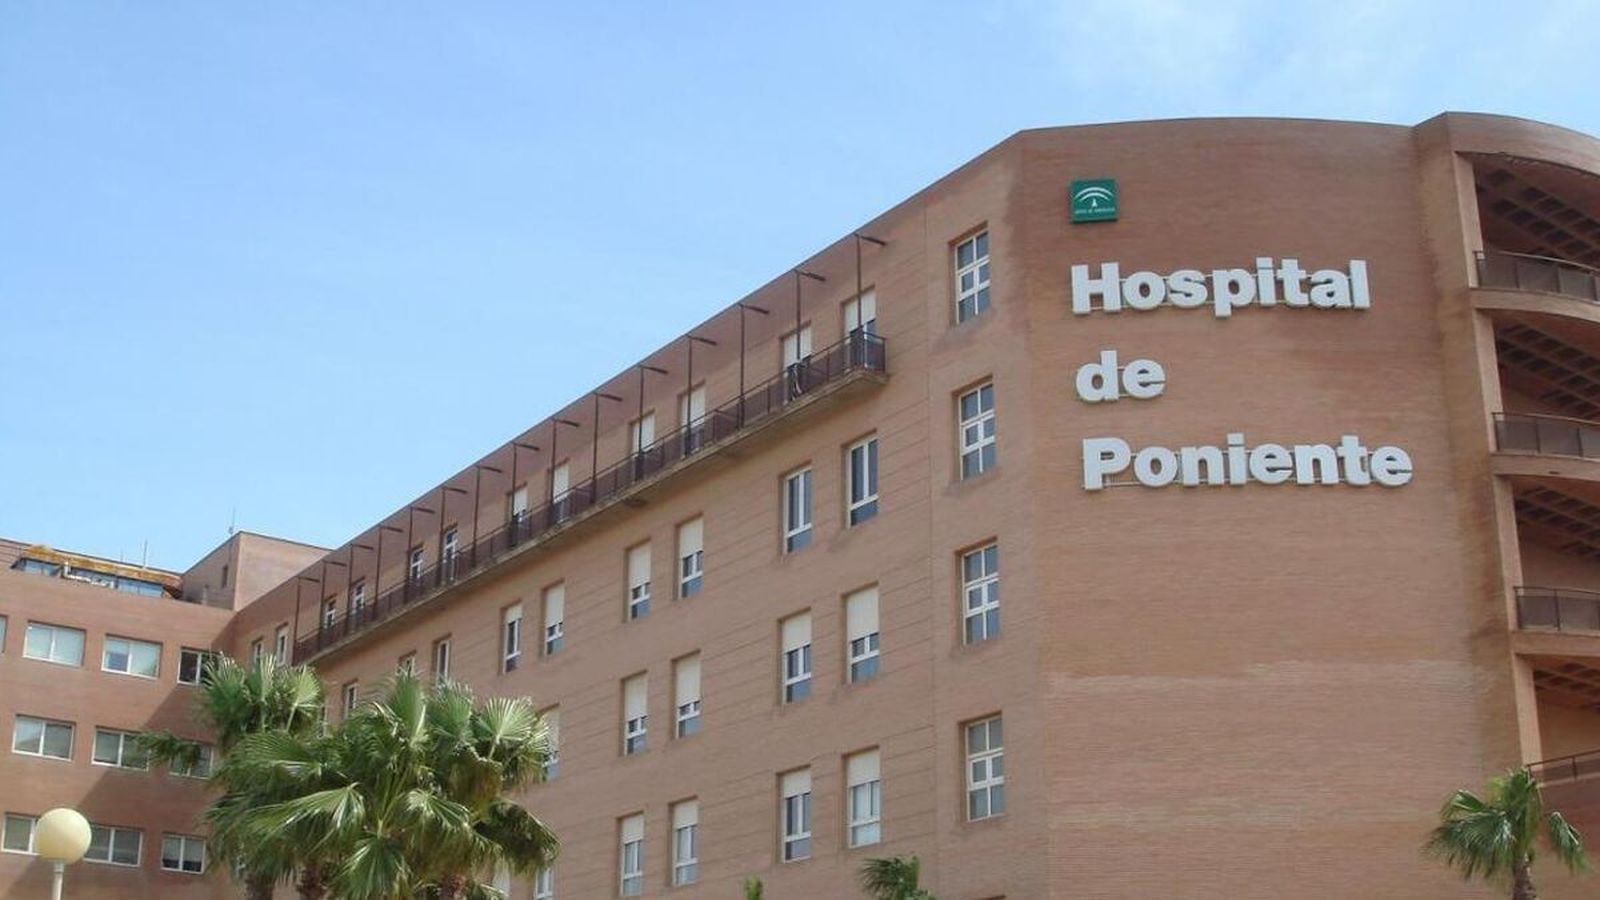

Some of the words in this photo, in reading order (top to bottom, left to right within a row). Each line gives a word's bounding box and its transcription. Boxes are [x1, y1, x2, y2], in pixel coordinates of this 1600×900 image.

[1071, 257, 1370, 317] Hospital
[1076, 350, 1166, 401] de
[1083, 433, 1413, 489] Poniente
